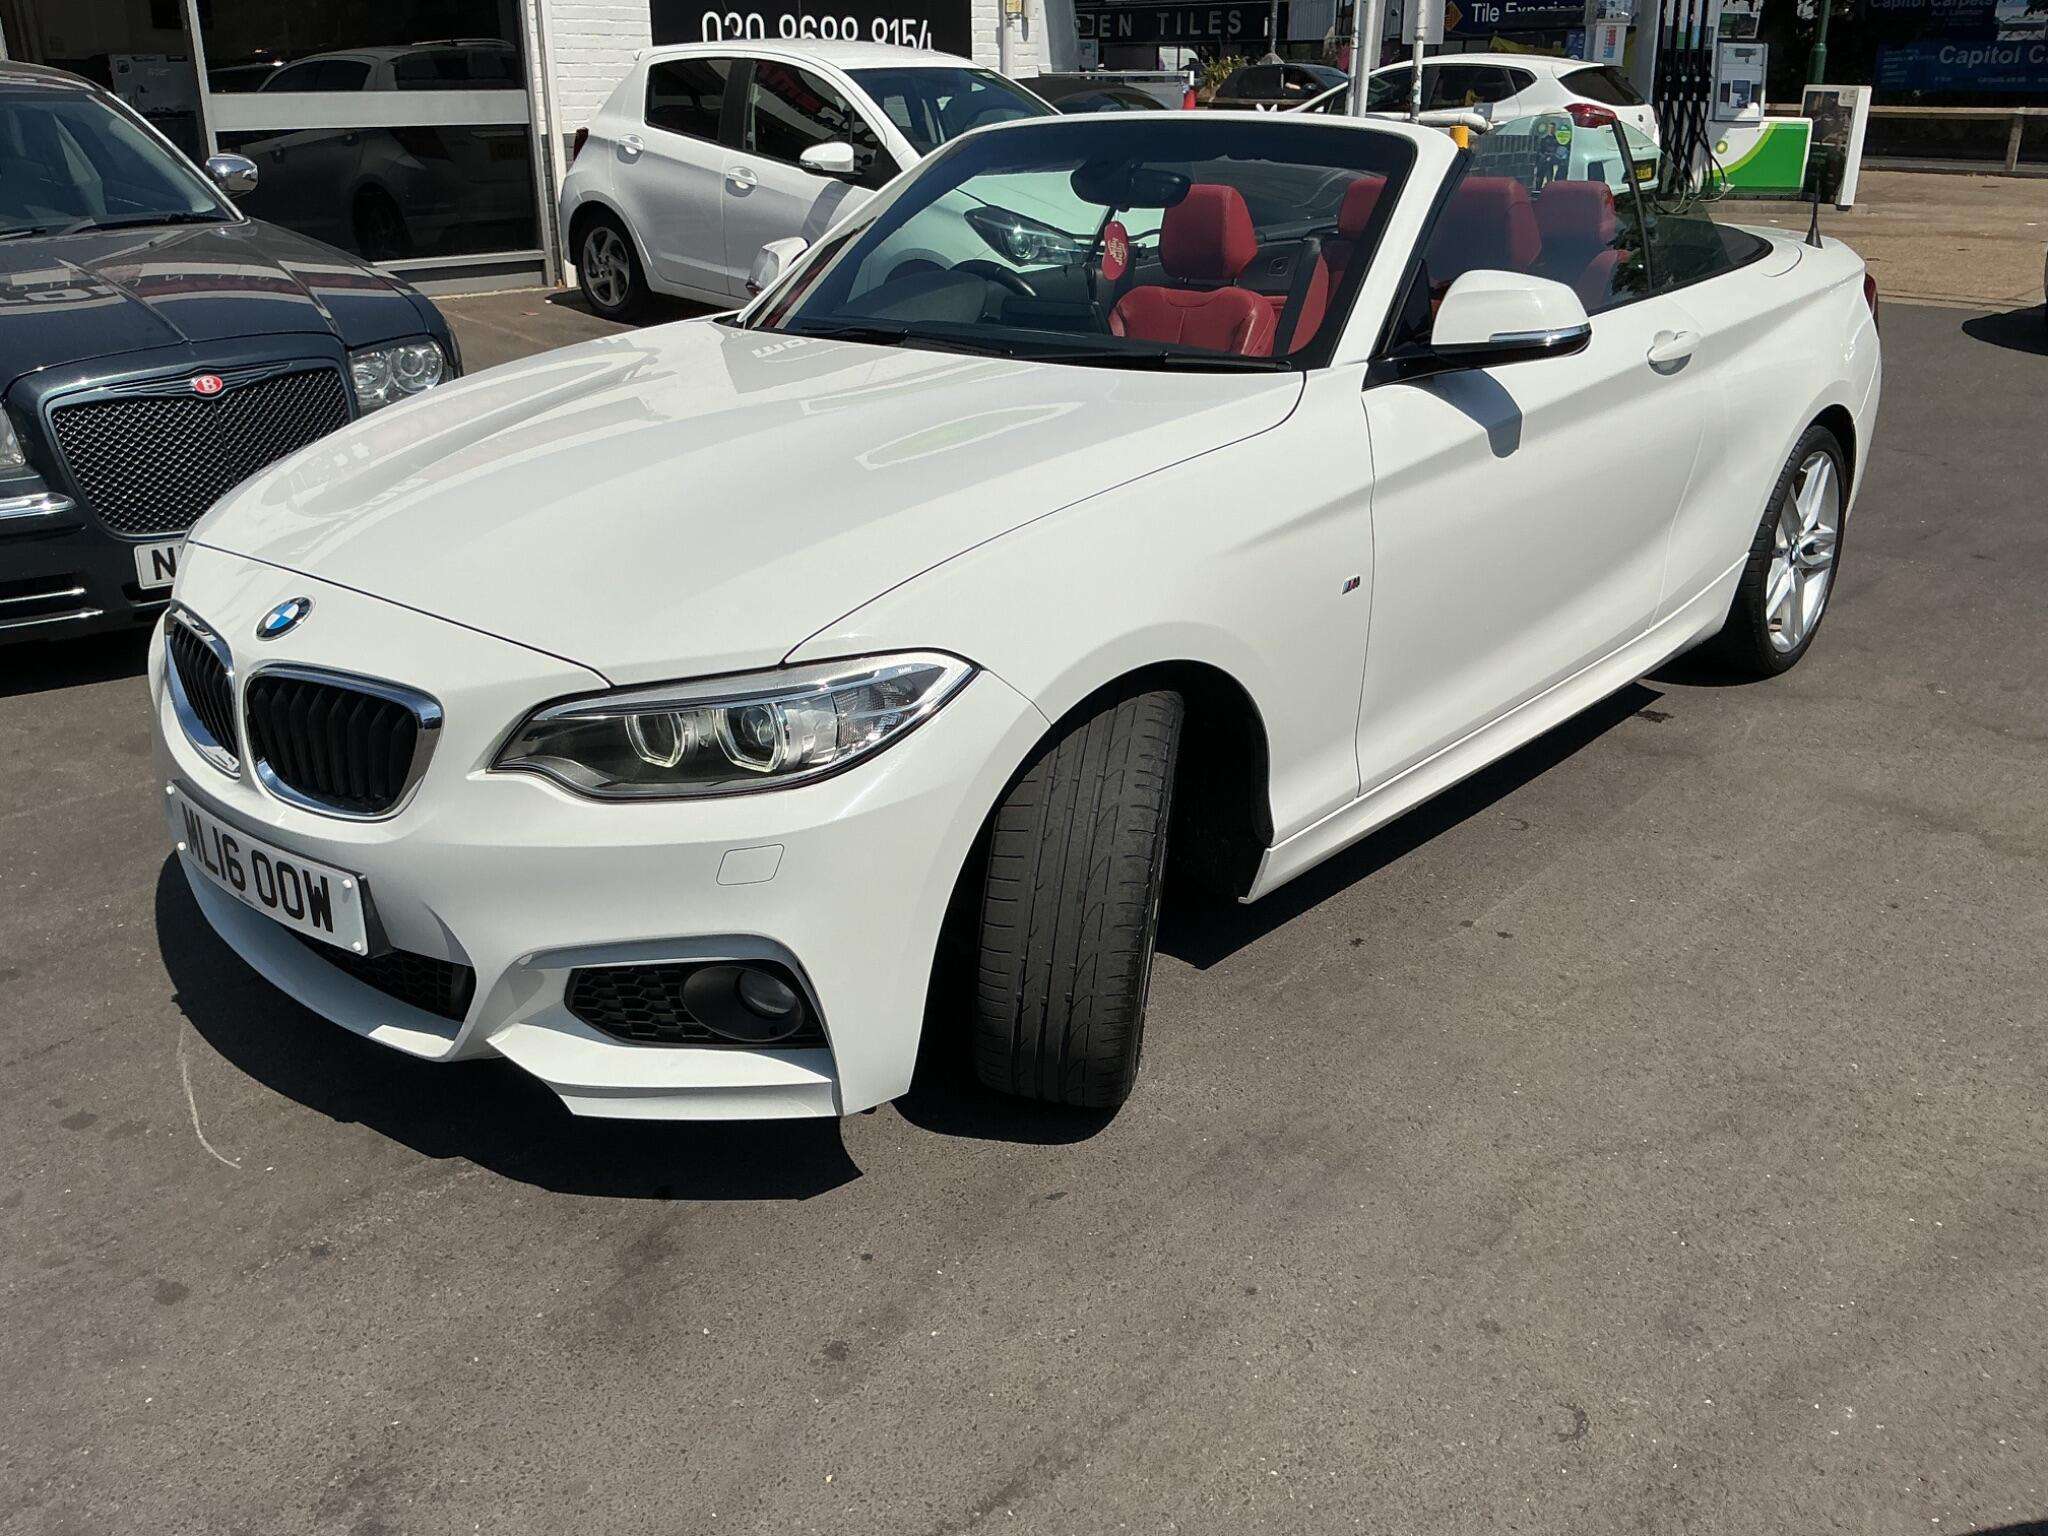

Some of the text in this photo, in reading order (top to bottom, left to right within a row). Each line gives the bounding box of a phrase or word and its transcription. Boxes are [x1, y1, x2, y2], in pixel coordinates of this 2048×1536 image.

[1156, 9, 1242, 36] TILES
[1471, 3, 1500, 22] Tile
[1938, 45, 2020, 68] Capitol
[181, 801, 247, 892] NL16
